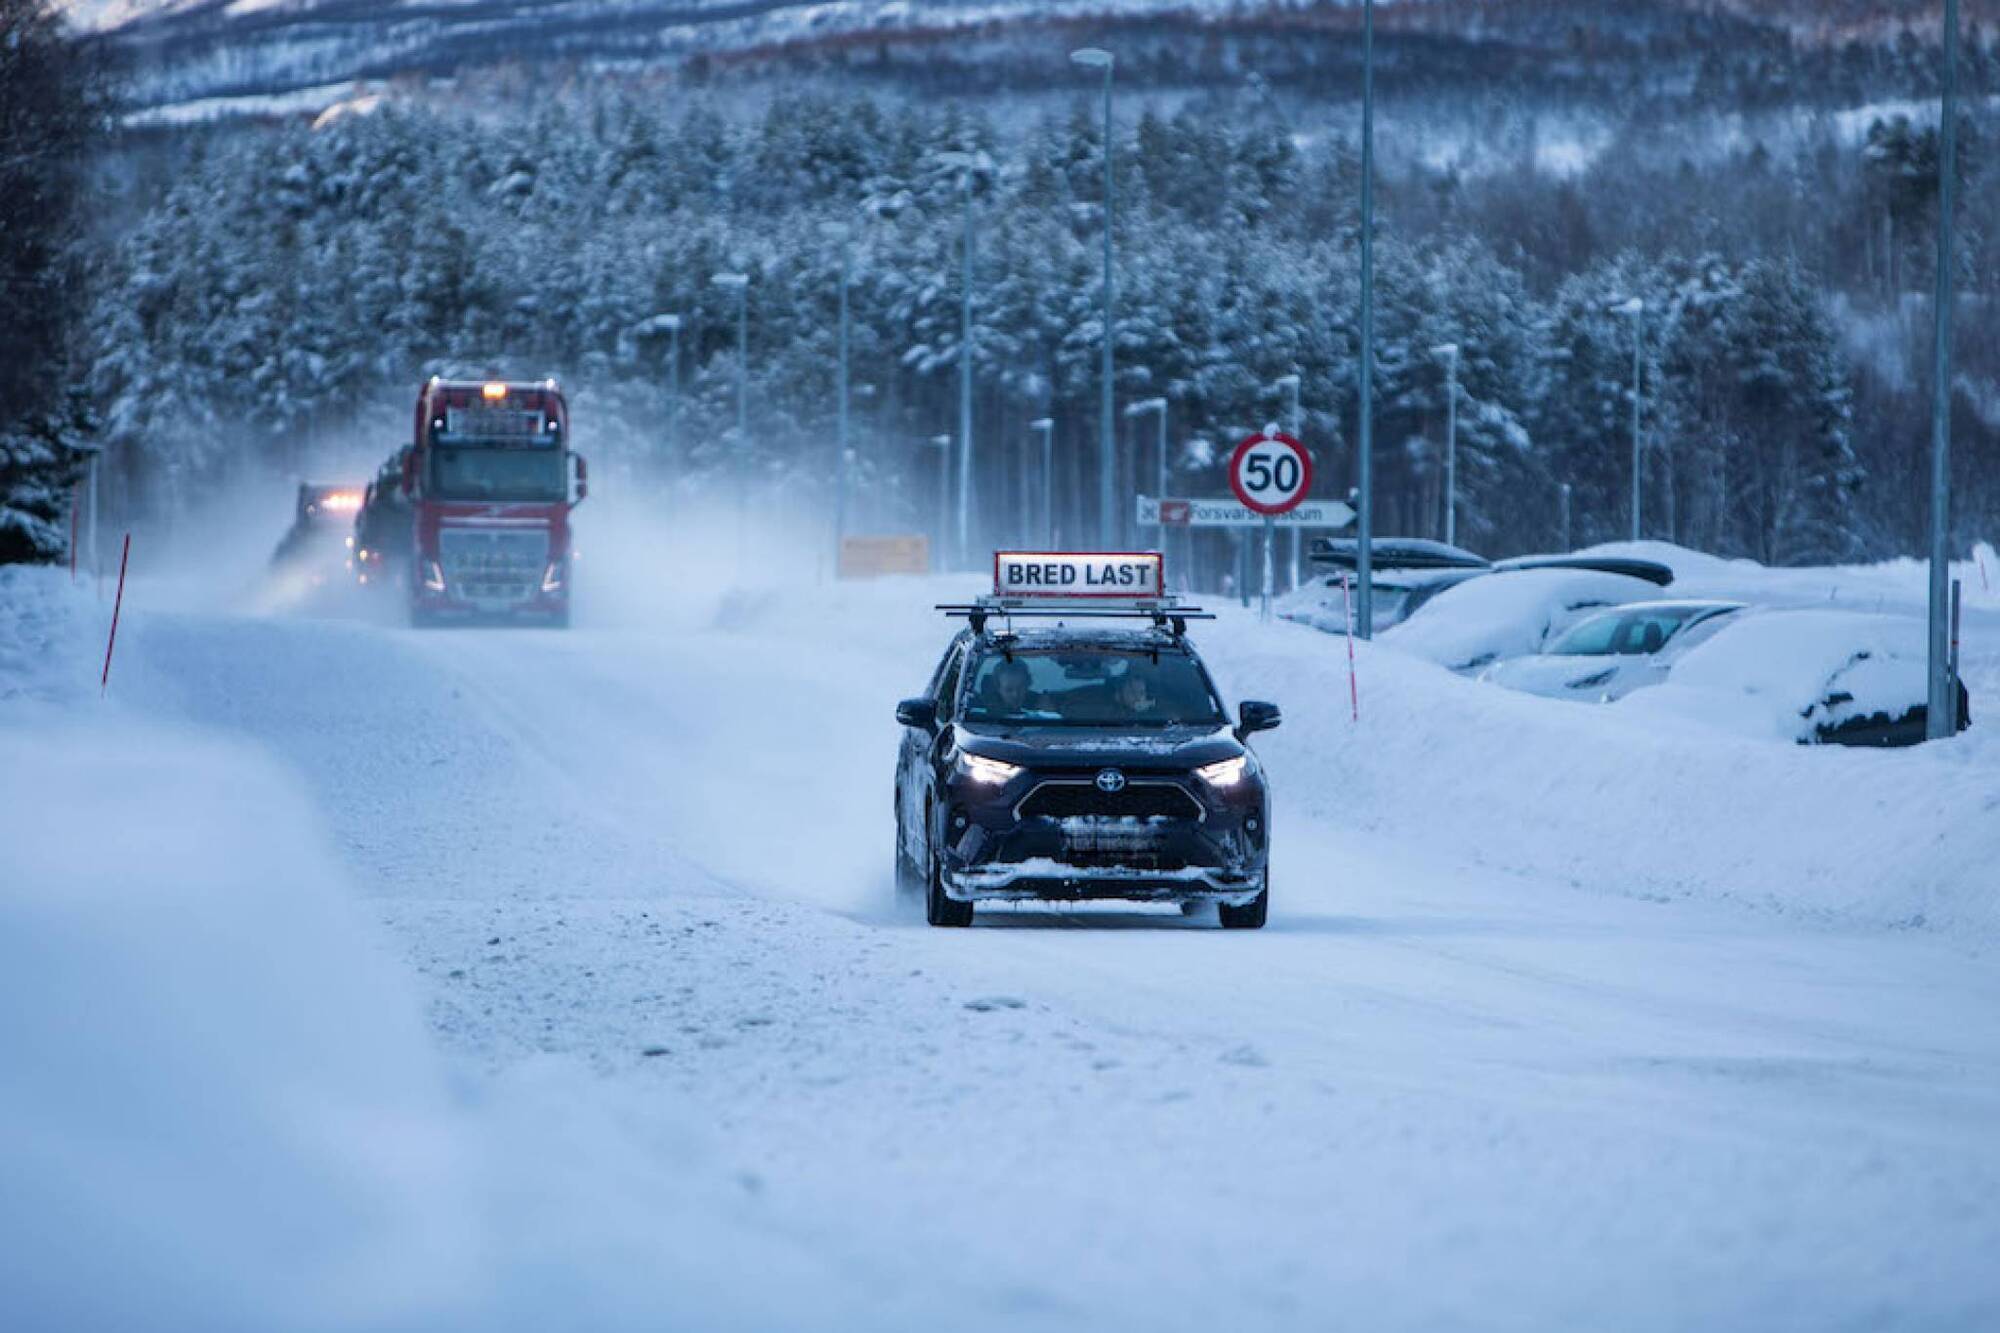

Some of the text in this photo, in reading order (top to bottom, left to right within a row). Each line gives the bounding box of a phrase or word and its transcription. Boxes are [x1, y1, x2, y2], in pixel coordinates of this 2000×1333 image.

[1246, 453, 1298, 492] 50
[1189, 503, 1322, 521] Forsvarsseum
[1007, 563, 1150, 586] BRED LAST
